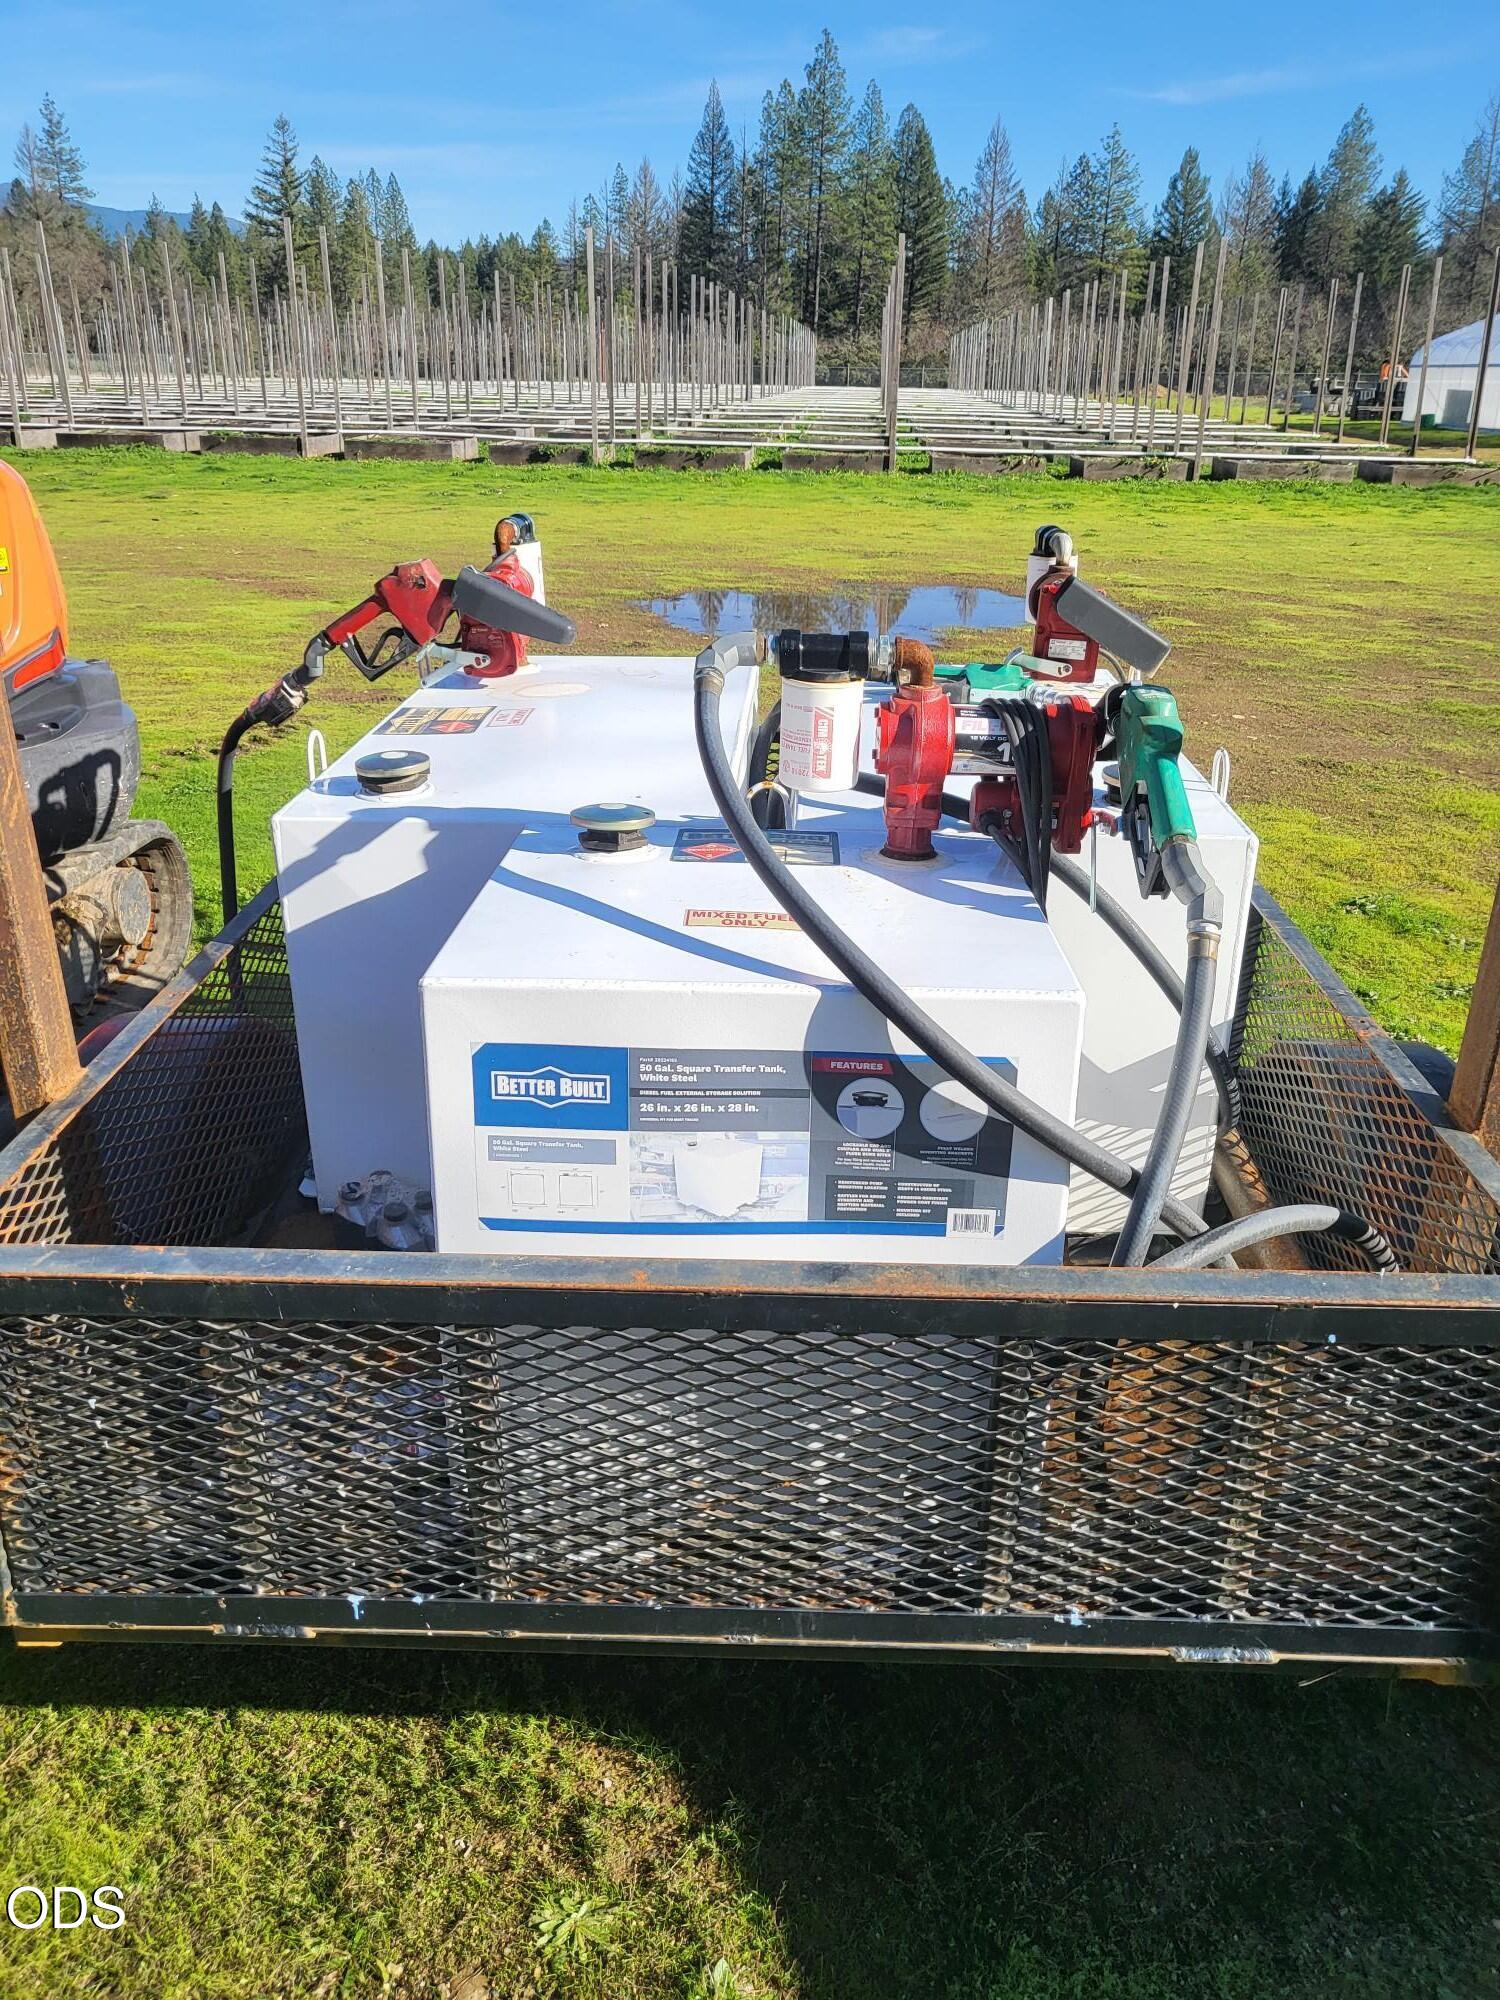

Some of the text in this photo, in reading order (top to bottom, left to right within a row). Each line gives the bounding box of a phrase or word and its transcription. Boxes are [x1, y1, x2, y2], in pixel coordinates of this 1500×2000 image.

[692, 911, 748, 920] MIXED
[721, 919, 769, 927] ONLY
[639, 1064, 787, 1075] 50 Gal. Square Transfer Tank,
[830, 1061, 884, 1071] FEATURES
[639, 1073, 698, 1082] White Steel
[496, 1075, 606, 1099] BETTER BUILT
[639, 1103, 654, 1112] 26
[656, 1103, 671, 1112] in.
[683, 1103, 698, 1112] 26
[700, 1104, 715, 1113] in.
[727, 1104, 742, 1112] 28
[744, 1104, 759, 1113] in.
